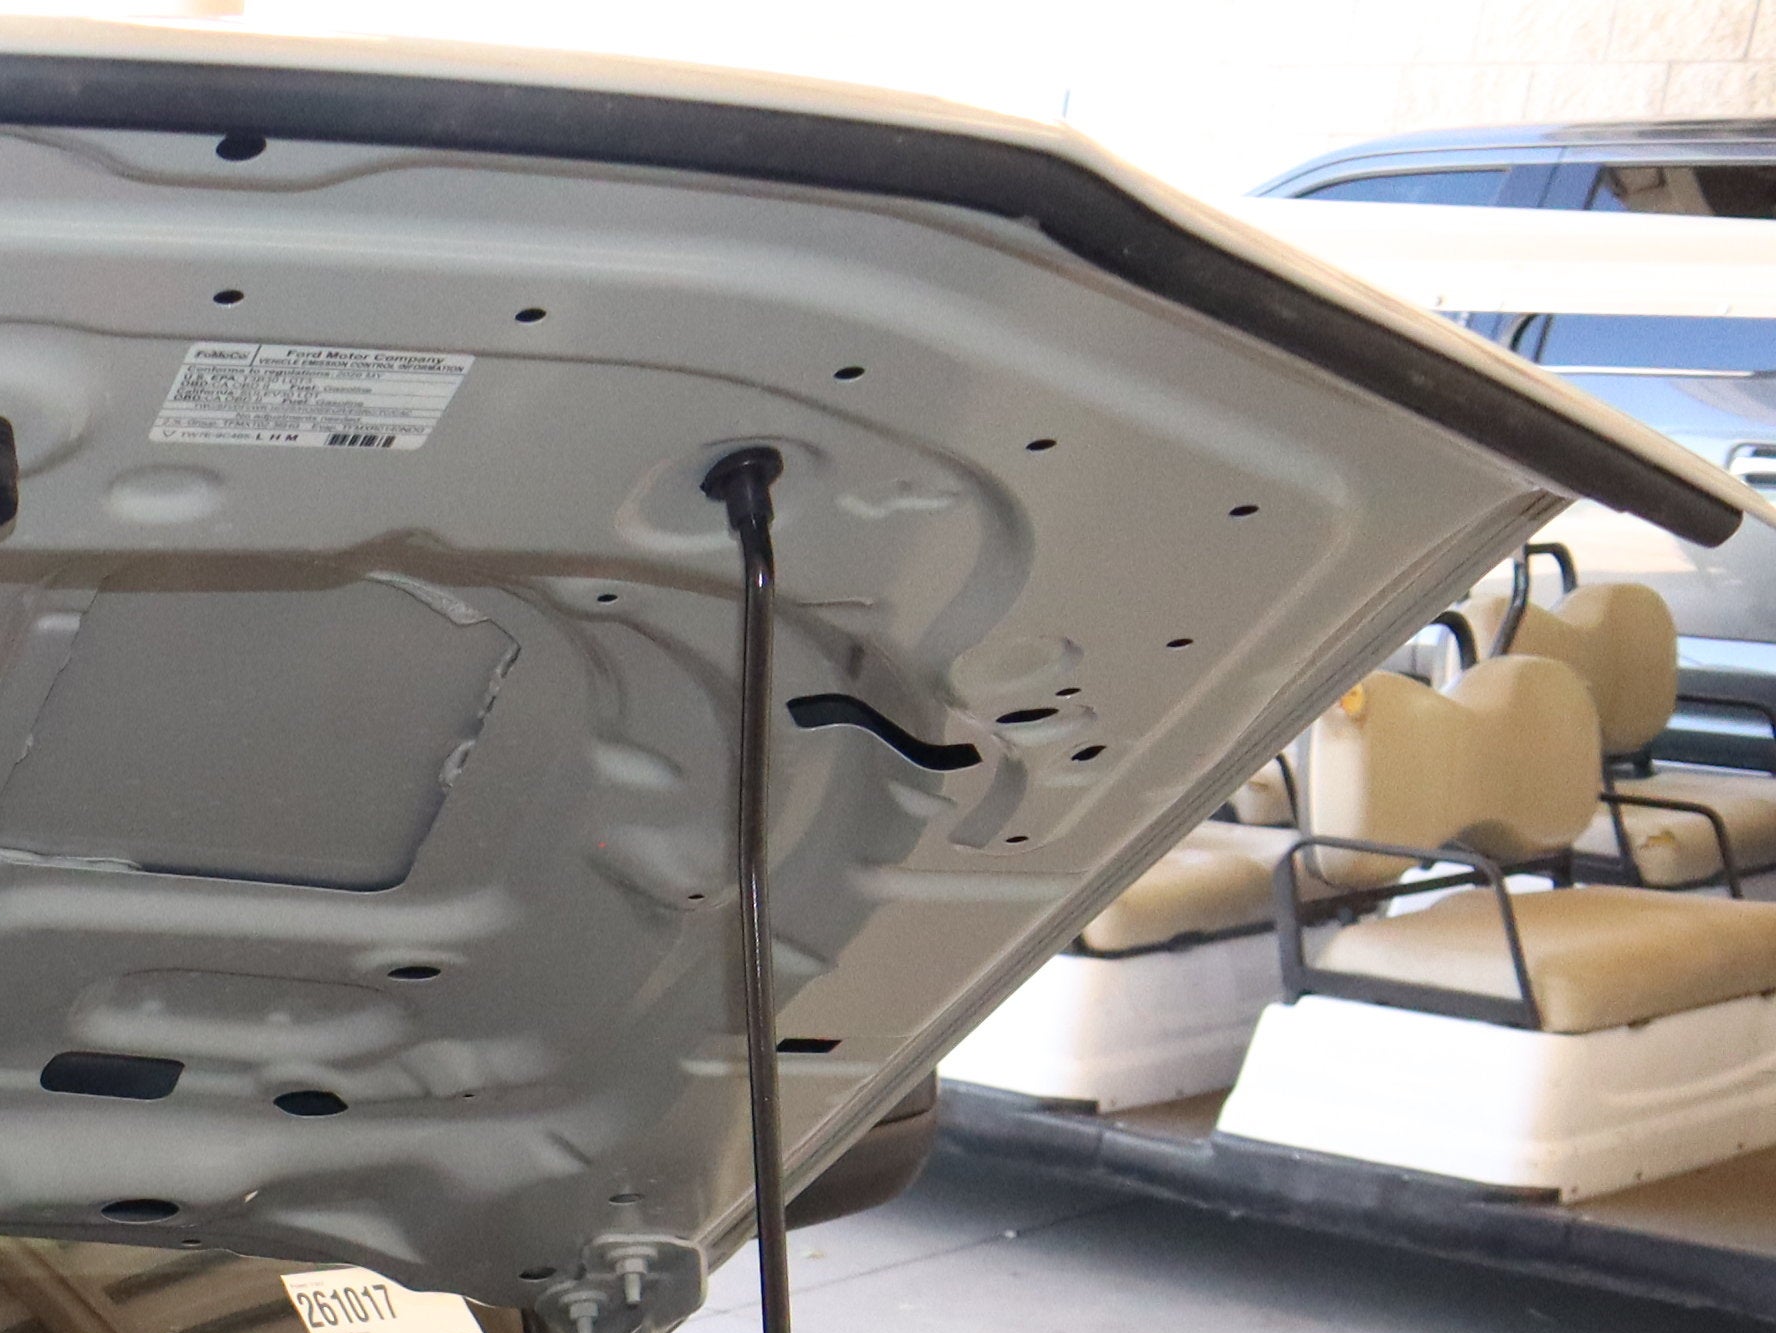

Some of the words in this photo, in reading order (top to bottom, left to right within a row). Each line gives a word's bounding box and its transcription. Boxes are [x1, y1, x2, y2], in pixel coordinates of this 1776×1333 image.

[195, 350, 249, 361] FoMoCo
[286, 349, 322, 359] Ford
[325, 351, 369, 361] Motor
[374, 353, 445, 365] Company
[186, 365, 246, 375] Conforms
[249, 367, 261, 375] to
[258, 358, 299, 367] VEHICLE
[301, 359, 347, 369] EMISSION
[350, 361, 395, 370] CONTROL
[398, 363, 465, 373] INFORMATION
[296, 1284, 397, 1328] 261017
